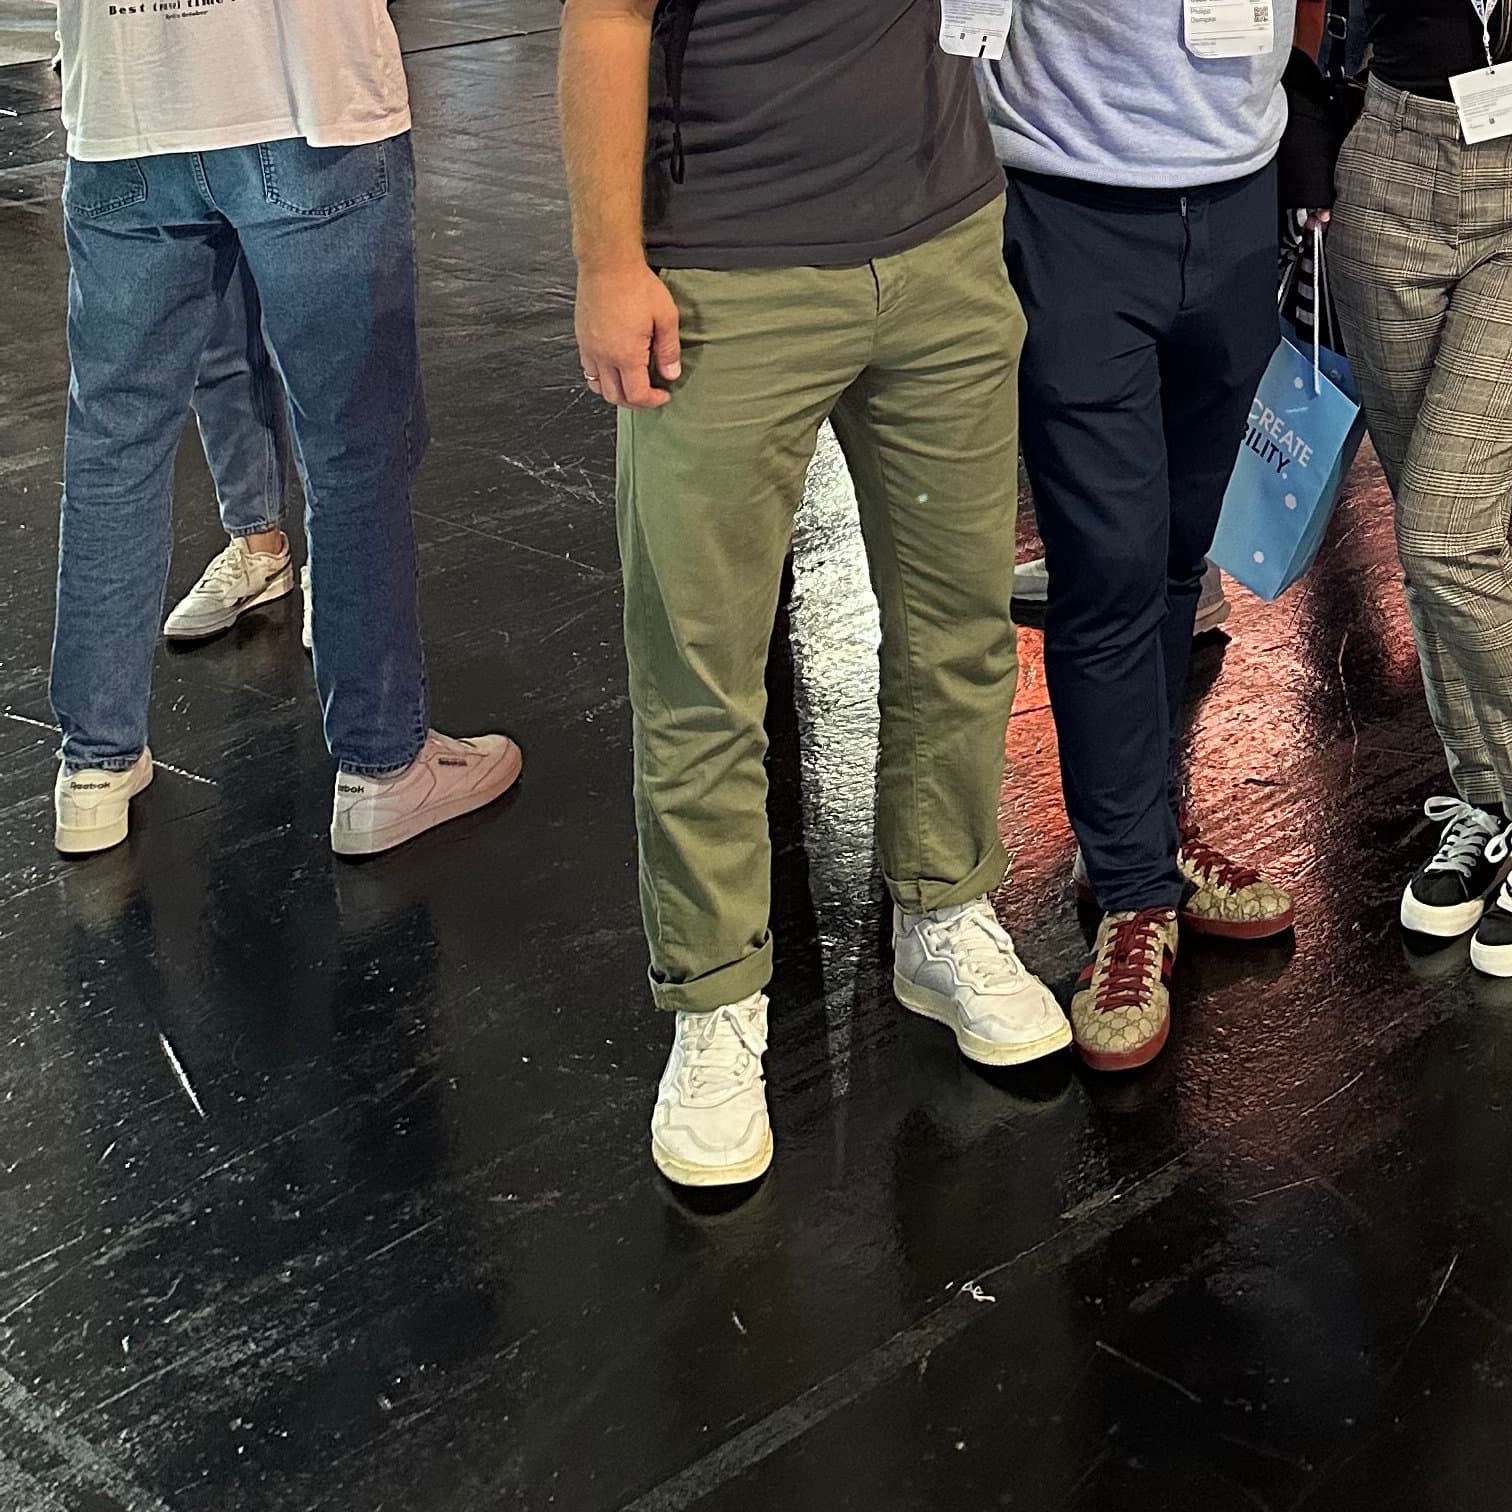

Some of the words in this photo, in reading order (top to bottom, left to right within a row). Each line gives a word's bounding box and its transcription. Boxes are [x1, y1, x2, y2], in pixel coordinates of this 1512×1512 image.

[108, 3, 146, 16] Best
[1249, 398, 1314, 469] CREATE
[71, 781, 111, 791] Reebok
